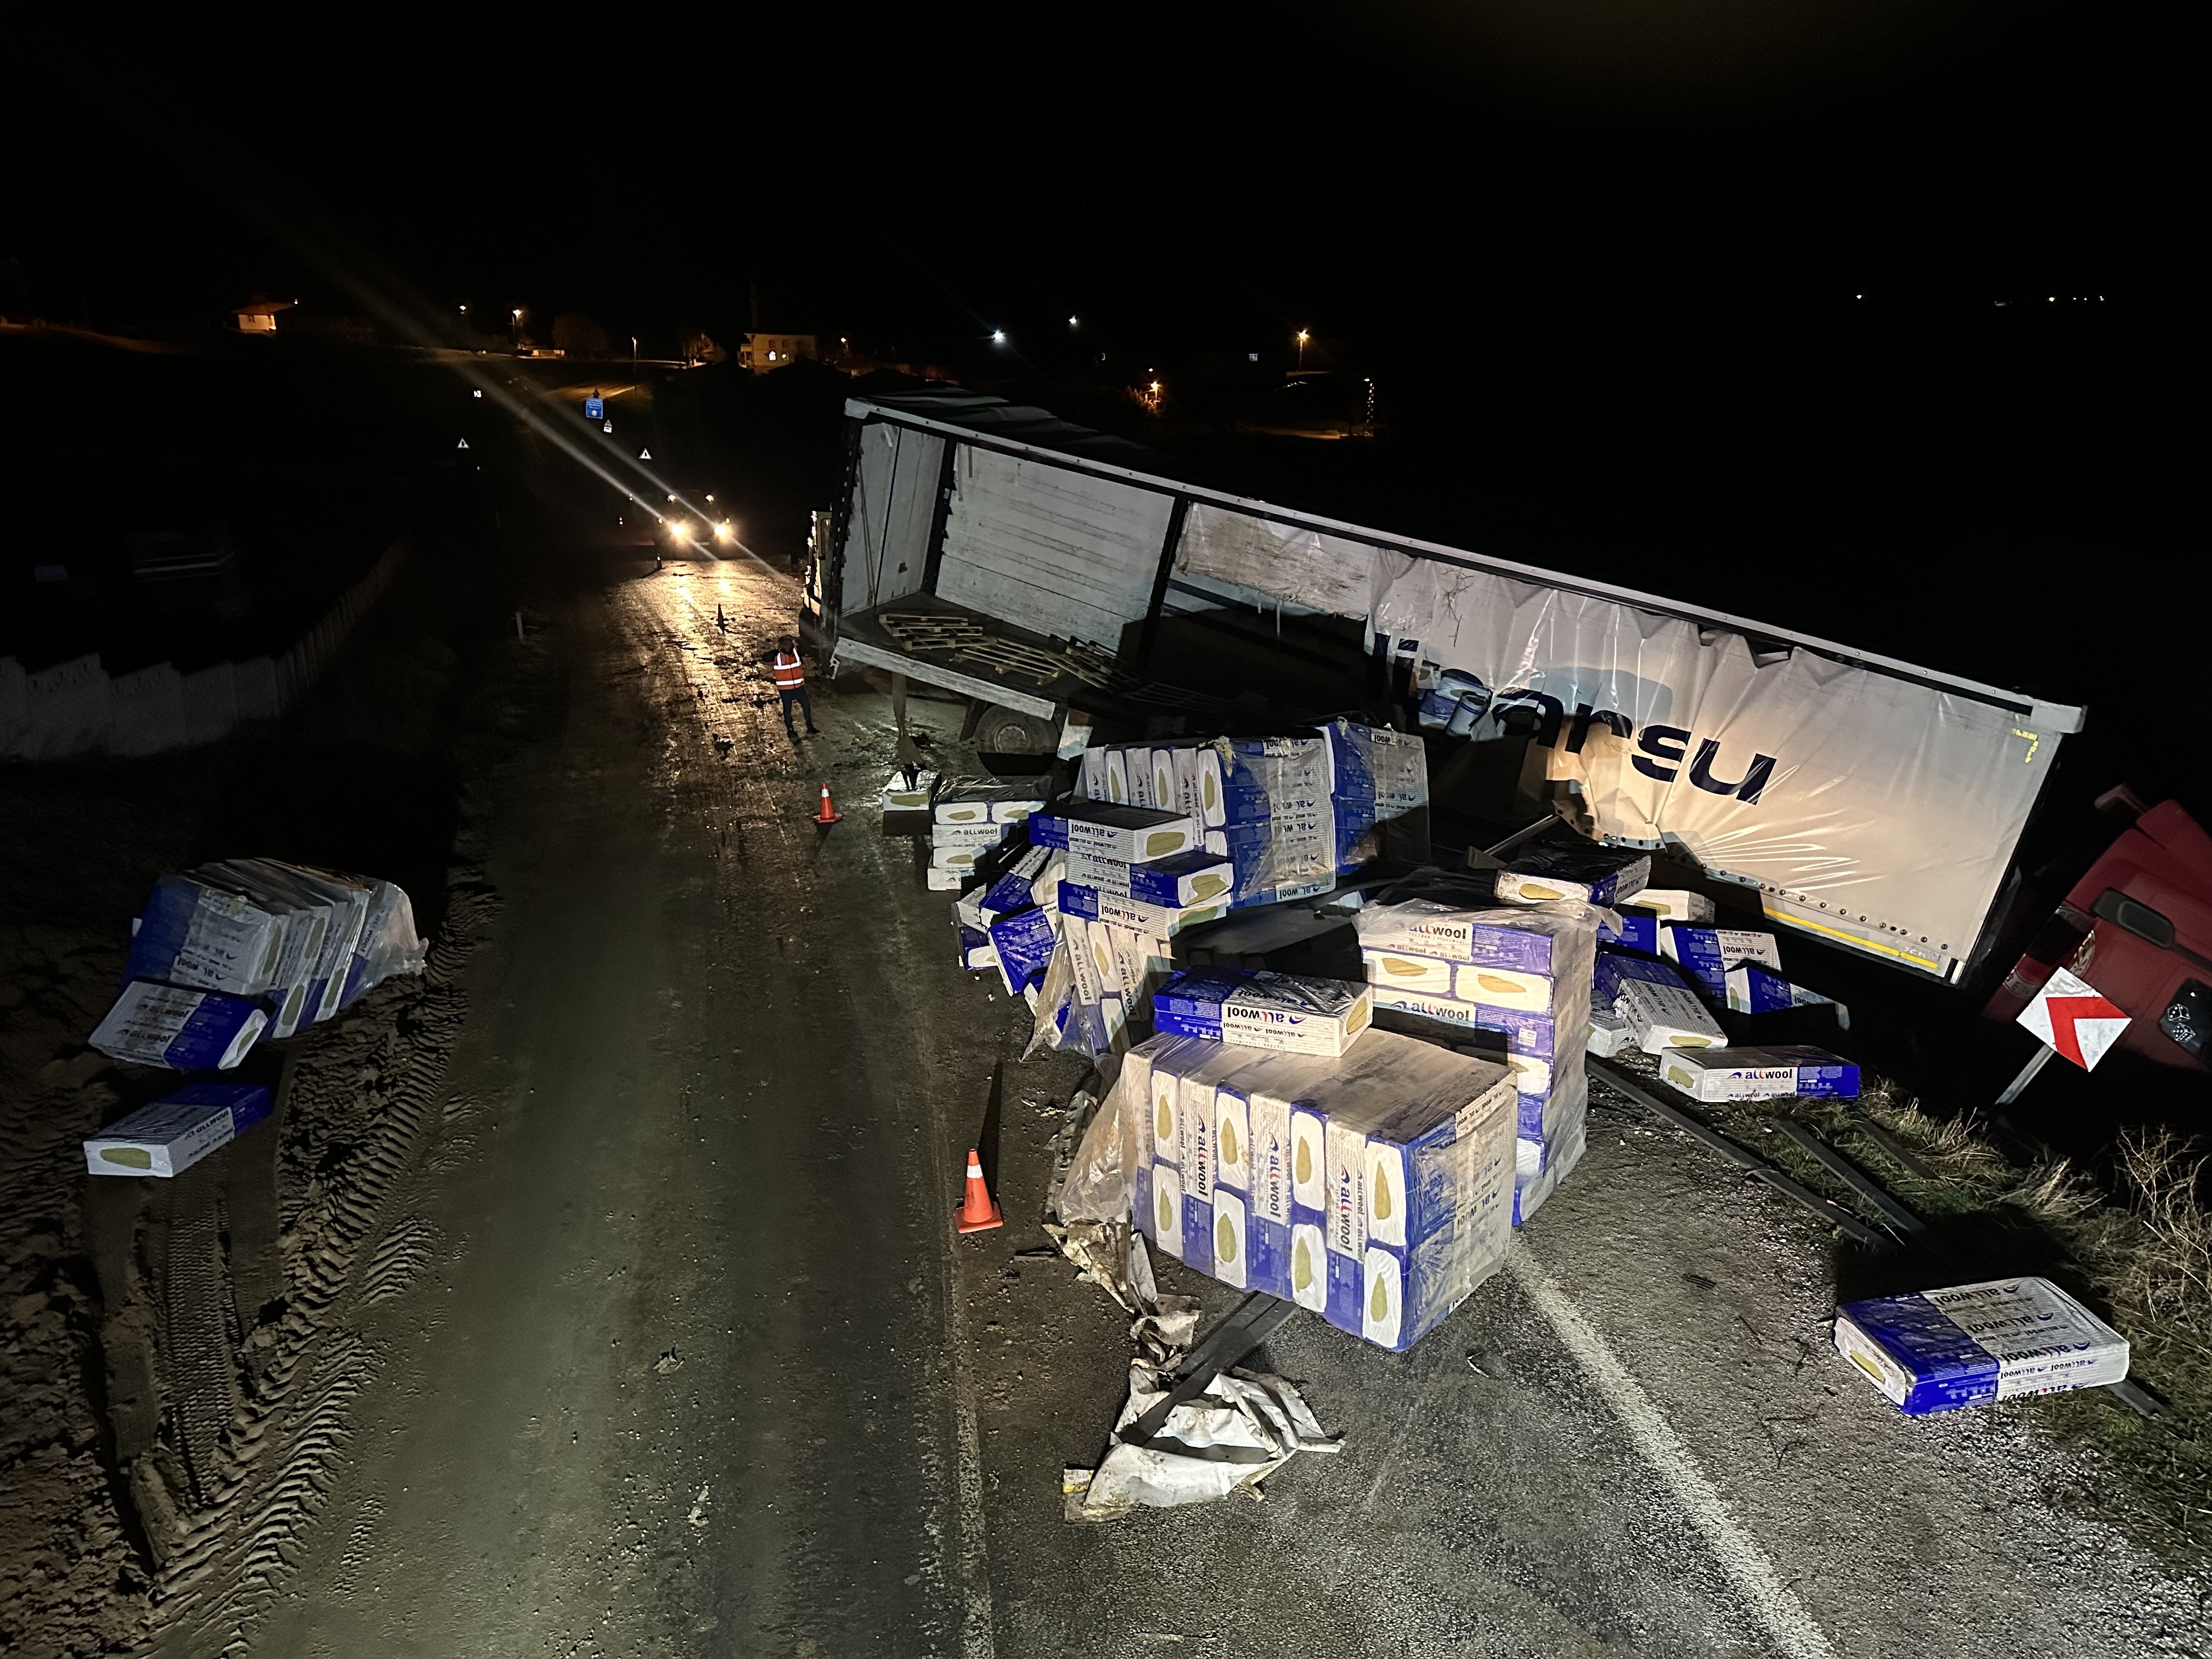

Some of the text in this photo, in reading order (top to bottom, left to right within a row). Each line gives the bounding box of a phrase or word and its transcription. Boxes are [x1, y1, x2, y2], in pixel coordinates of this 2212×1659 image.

[1367, 631, 1776, 805] liarsu
[1071, 823, 1104, 838] allwool
[1102, 905, 1136, 922] allwool
[1397, 945, 1470, 961] allwool allwool
[1723, 946, 1755, 956] allwool
[1074, 953, 1091, 1000] allwool
[1227, 1007, 1284, 1024] allwool
[1411, 1002, 1469, 1021] allwool
[1223, 1022, 1295, 1037] allwool allwool
[1745, 1068, 1792, 1080] allwool
[1198, 1136, 1208, 1197] allwool
[1269, 1155, 1282, 1218] allwool
[1340, 1189, 1352, 1251] allwool
[1934, 1287, 2001, 1306] allwool
[1967, 1316, 2034, 1334] allwool
[2001, 1344, 2071, 1363] allwool
[2000, 1361, 2085, 1379] allwool allwool
